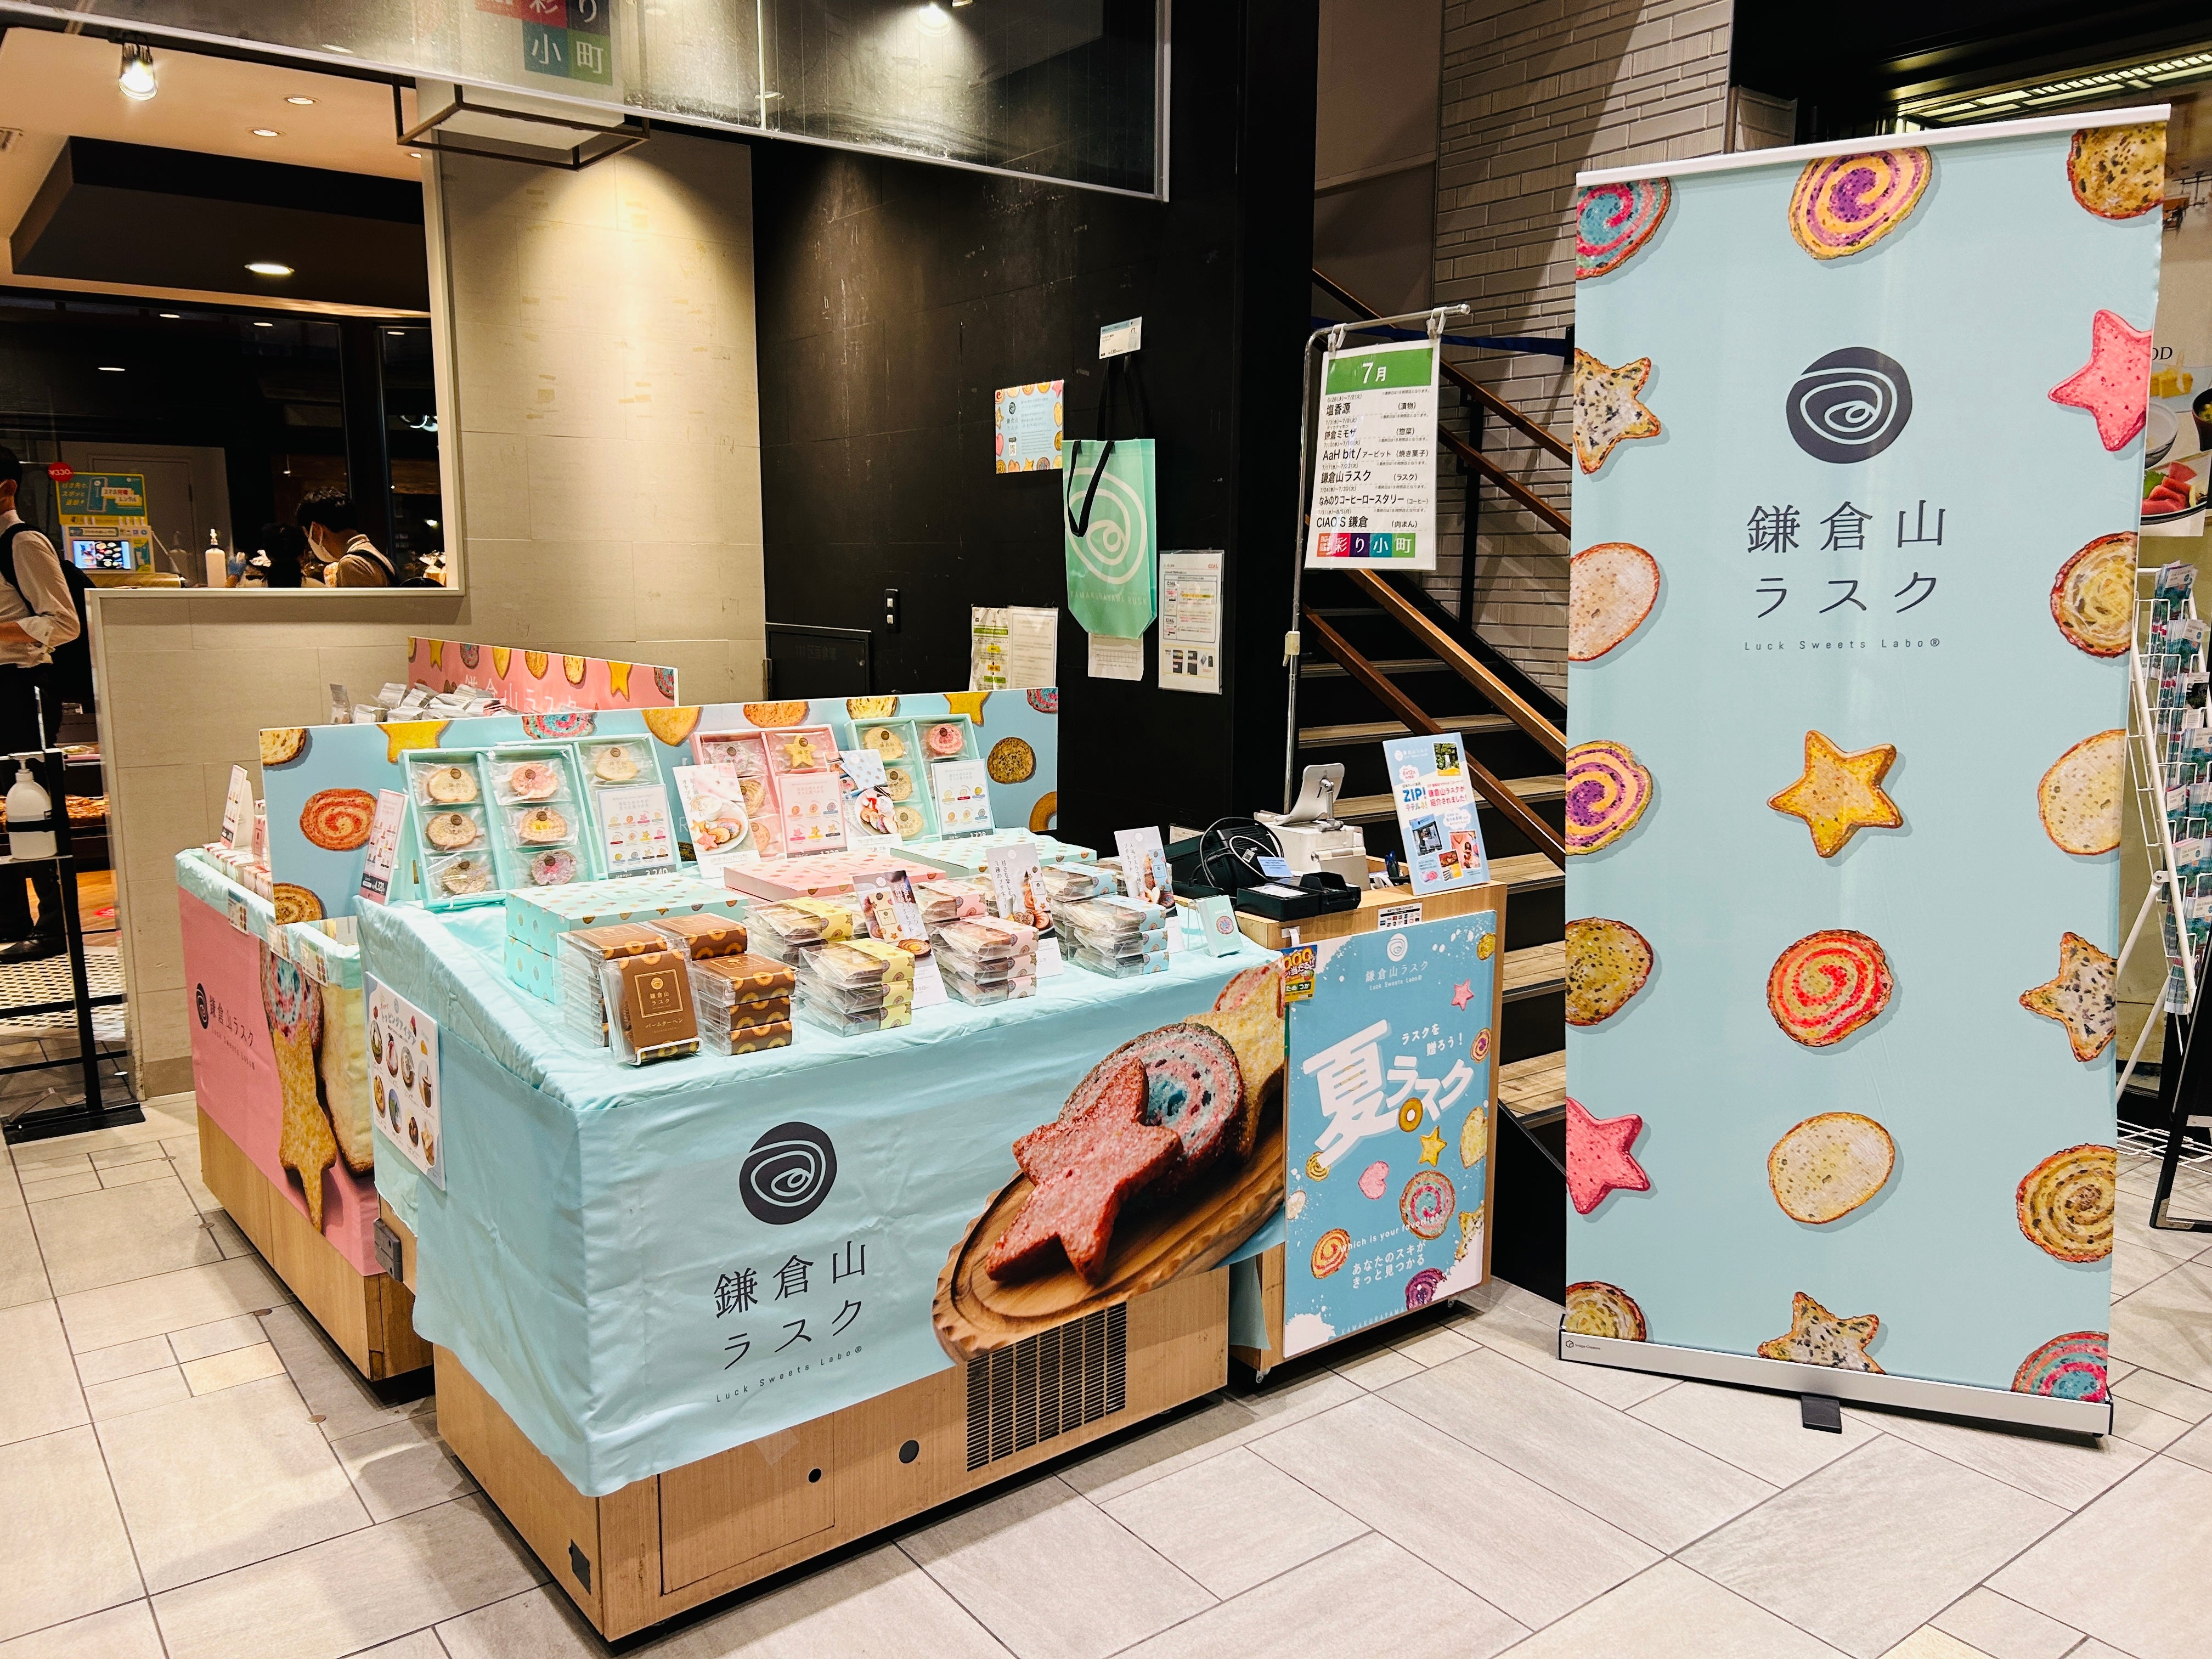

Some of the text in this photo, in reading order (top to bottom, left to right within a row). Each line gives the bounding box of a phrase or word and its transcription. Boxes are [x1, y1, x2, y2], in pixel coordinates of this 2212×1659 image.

[532, 33, 603, 74] 小町
[1363, 362, 1386, 383] 7月
[1321, 470, 1418, 484] 鎌倉山ラスク (ラスク)
[1319, 494, 1404, 506] なみのりコーヒーロースタリー
[1348, 516, 1368, 528] 鎌倉
[1746, 500, 1946, 553] 鎌倉山
[1128, 596, 1148, 606] RUSK
[1756, 572, 1937, 618] ラスク
[1745, 641, 1785, 651] Luck
[1799, 640, 1866, 650] Sweets
[1365, 961, 1428, 983] 鎌倉山ラスク
[650, 991, 670, 999] 鎌倉山
[1401, 1023, 1440, 1046] ラスクを
[1369, 1233, 1377, 1243] is
[1379, 1226, 1400, 1239] your
[1352, 1239, 1427, 1275] あなたのスキが
[713, 1240, 866, 1318] 鎌倉山
[1351, 1252, 1425, 1289] きっと見つかる
[724, 1300, 862, 1370] ラスク
[716, 1385, 748, 1403] Luck
[759, 1363, 810, 1387] Sweets
